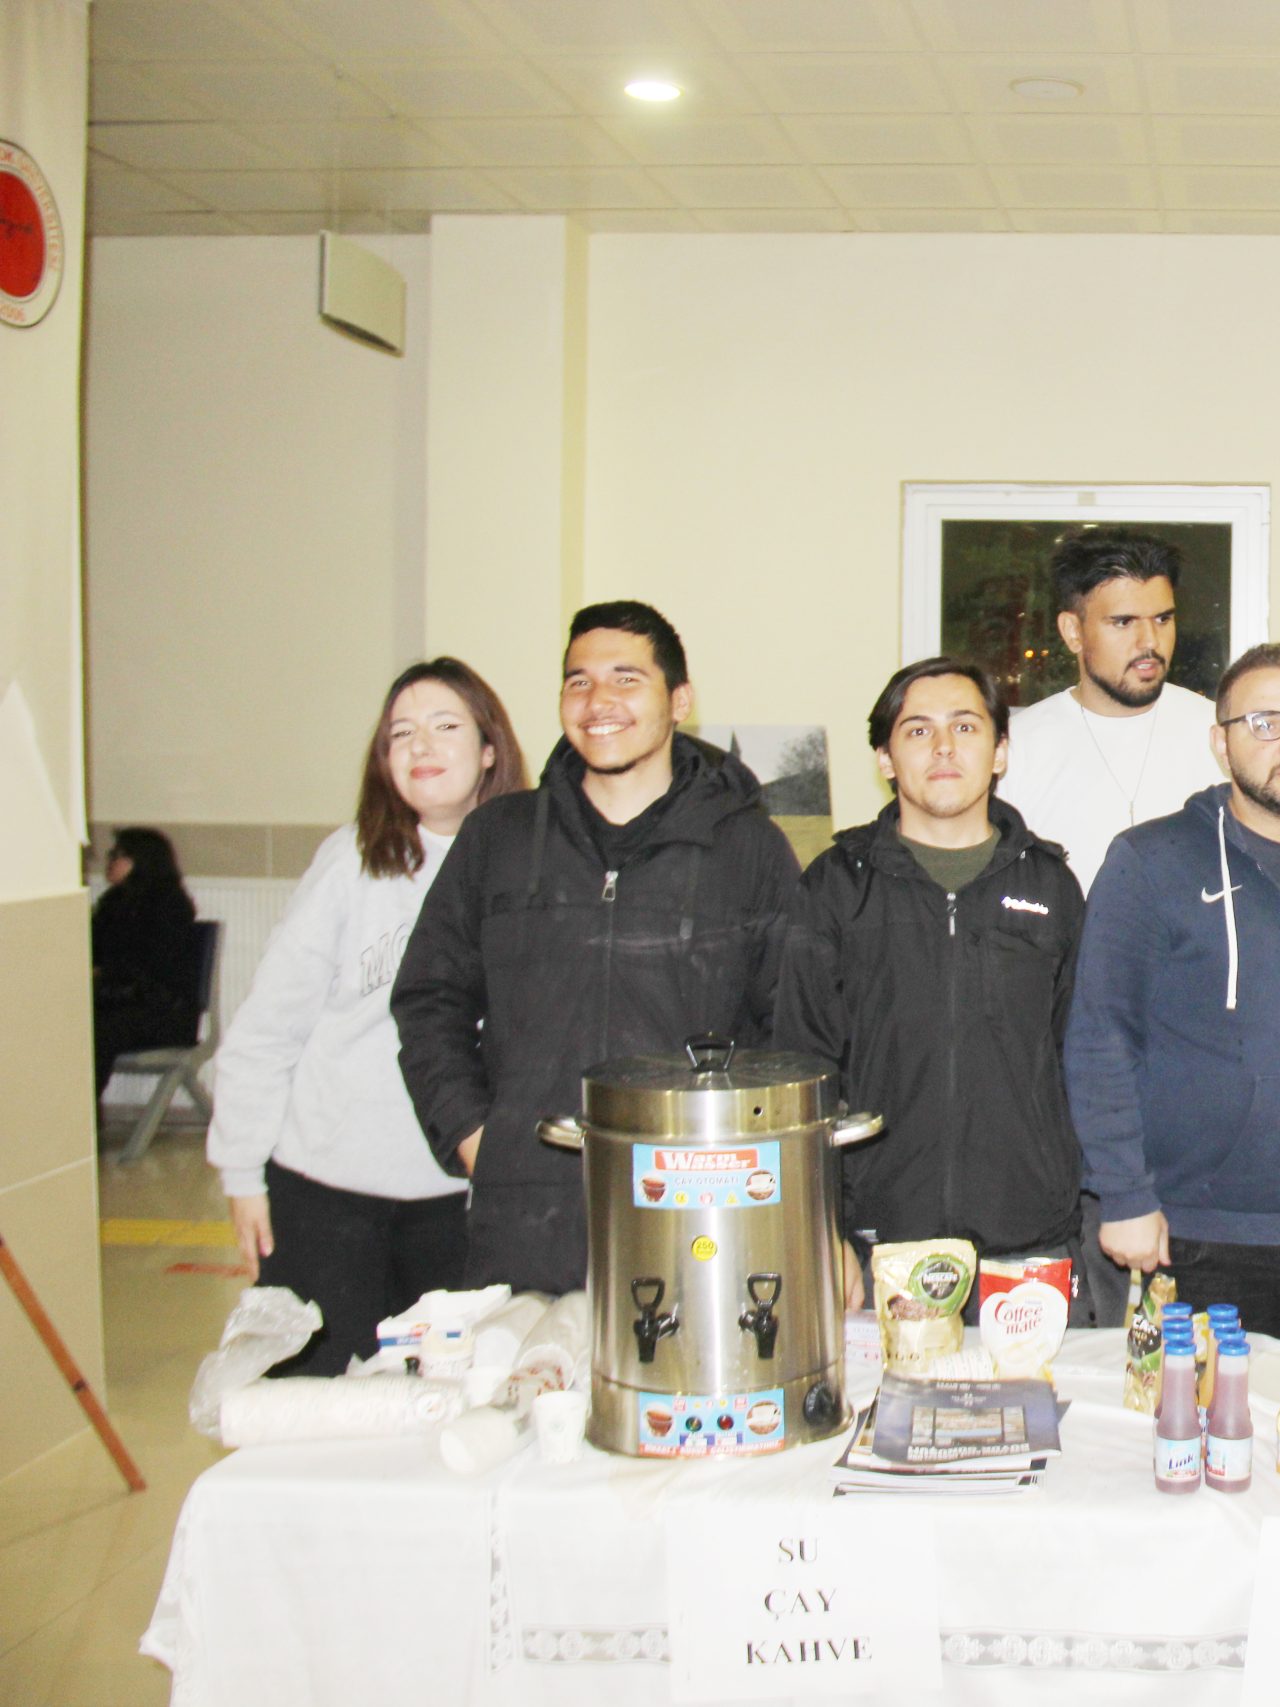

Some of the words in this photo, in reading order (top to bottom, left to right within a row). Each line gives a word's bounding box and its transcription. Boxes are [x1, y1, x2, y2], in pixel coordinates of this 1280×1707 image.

[778, 1537, 820, 1563] SU
[764, 1588, 837, 1621] ÇAY
[746, 1636, 873, 1665] KAHVE
